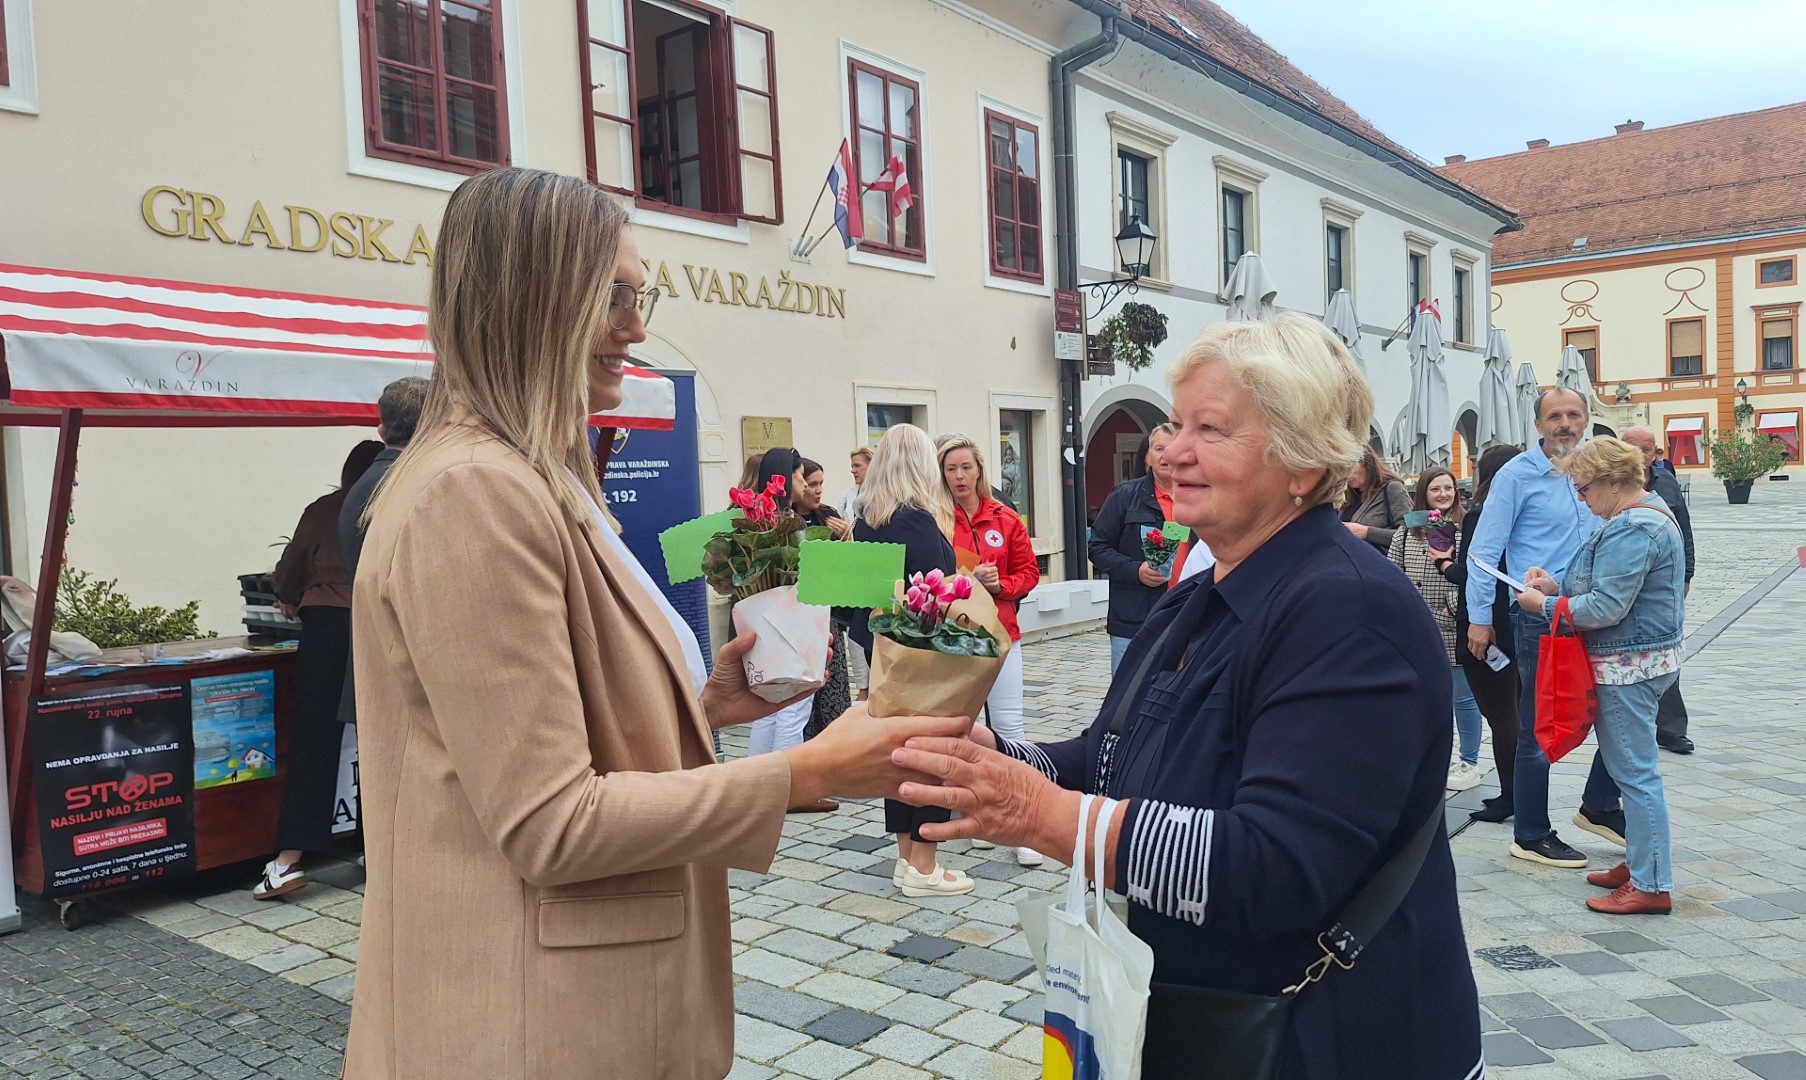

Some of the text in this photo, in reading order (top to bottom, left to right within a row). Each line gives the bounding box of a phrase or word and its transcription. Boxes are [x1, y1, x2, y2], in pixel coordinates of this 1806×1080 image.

[141, 185, 847, 319] GRADSKA A VARAŽDIN
[606, 459, 670, 470] PRAVA VARAŽDINSKA
[603, 470, 660, 480] zdinska.policija.hr
[612, 489, 637, 503] 192
[87, 707, 133, 720] 22. rujna
[45, 758, 71, 769] NEMA
[73, 750, 130, 765] OPRAVDANJA
[144, 742, 179, 753] NASILJE
[65, 772, 174, 810] STOP
[50, 795, 182, 829] NASILJU NAD ŽENAMA
[77, 835, 101, 845] NAZOVI
[105, 828, 129, 838] PRIJAVI
[78, 843, 99, 852] SUTRA
[100, 838, 118, 847] MOŽE
[53, 874, 91, 887] dostupne
[92, 868, 110, 878] 0-24
[131, 861, 137, 869] 7
[138, 858, 157, 867] dana
[144, 867, 164, 878] 112
